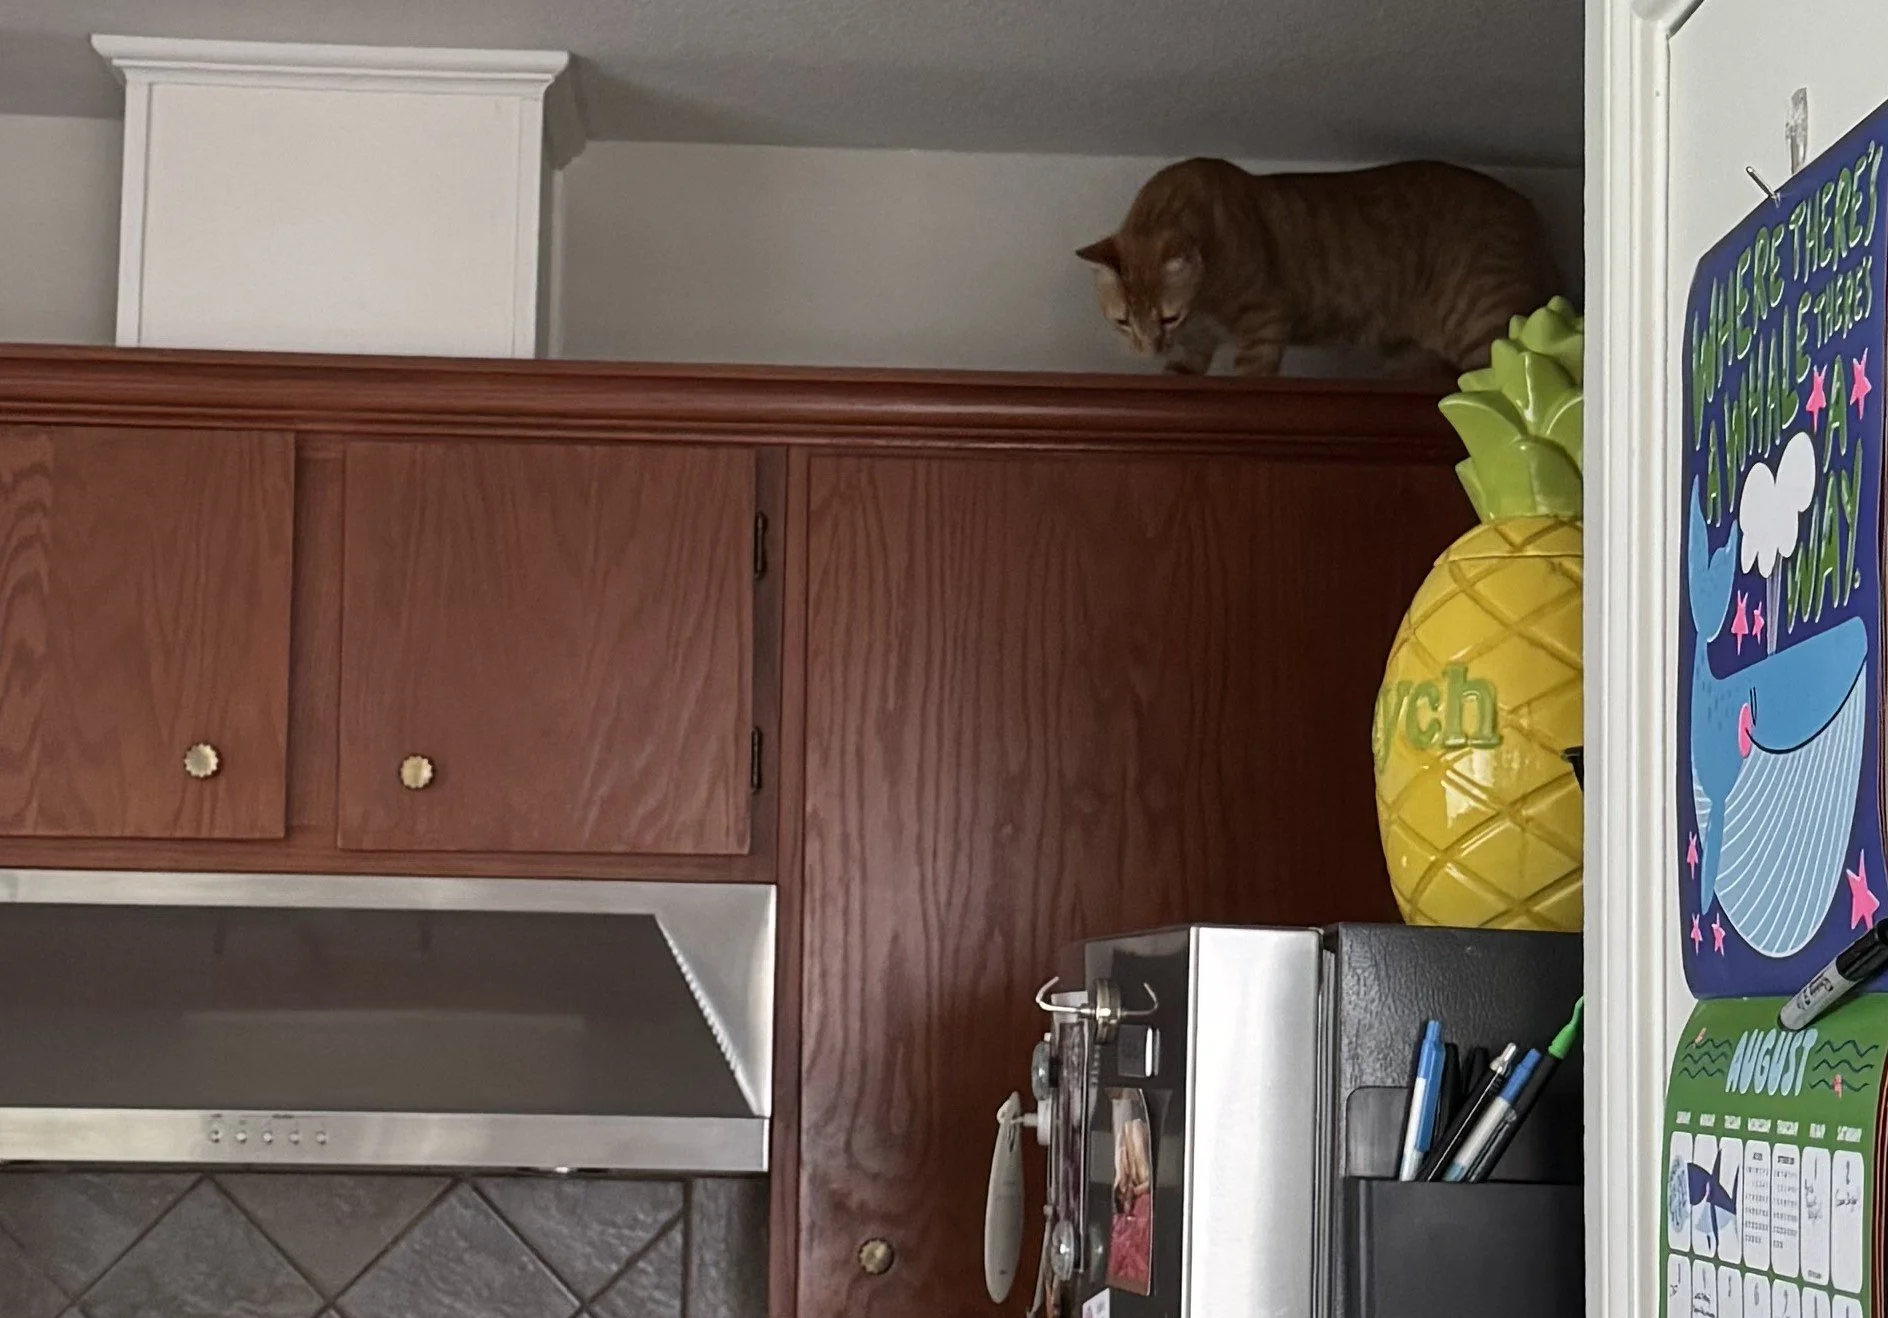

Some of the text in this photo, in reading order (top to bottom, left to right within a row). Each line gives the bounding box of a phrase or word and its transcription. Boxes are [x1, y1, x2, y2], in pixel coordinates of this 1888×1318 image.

[1691, 140, 1884, 452] WHERE THERE'S
[1706, 255, 1873, 529] A WHALE THERE'S
[1823, 353, 1848, 474] A
[1787, 438, 1864, 635] WAY.
[1724, 1027, 1819, 1097] AUGUST
